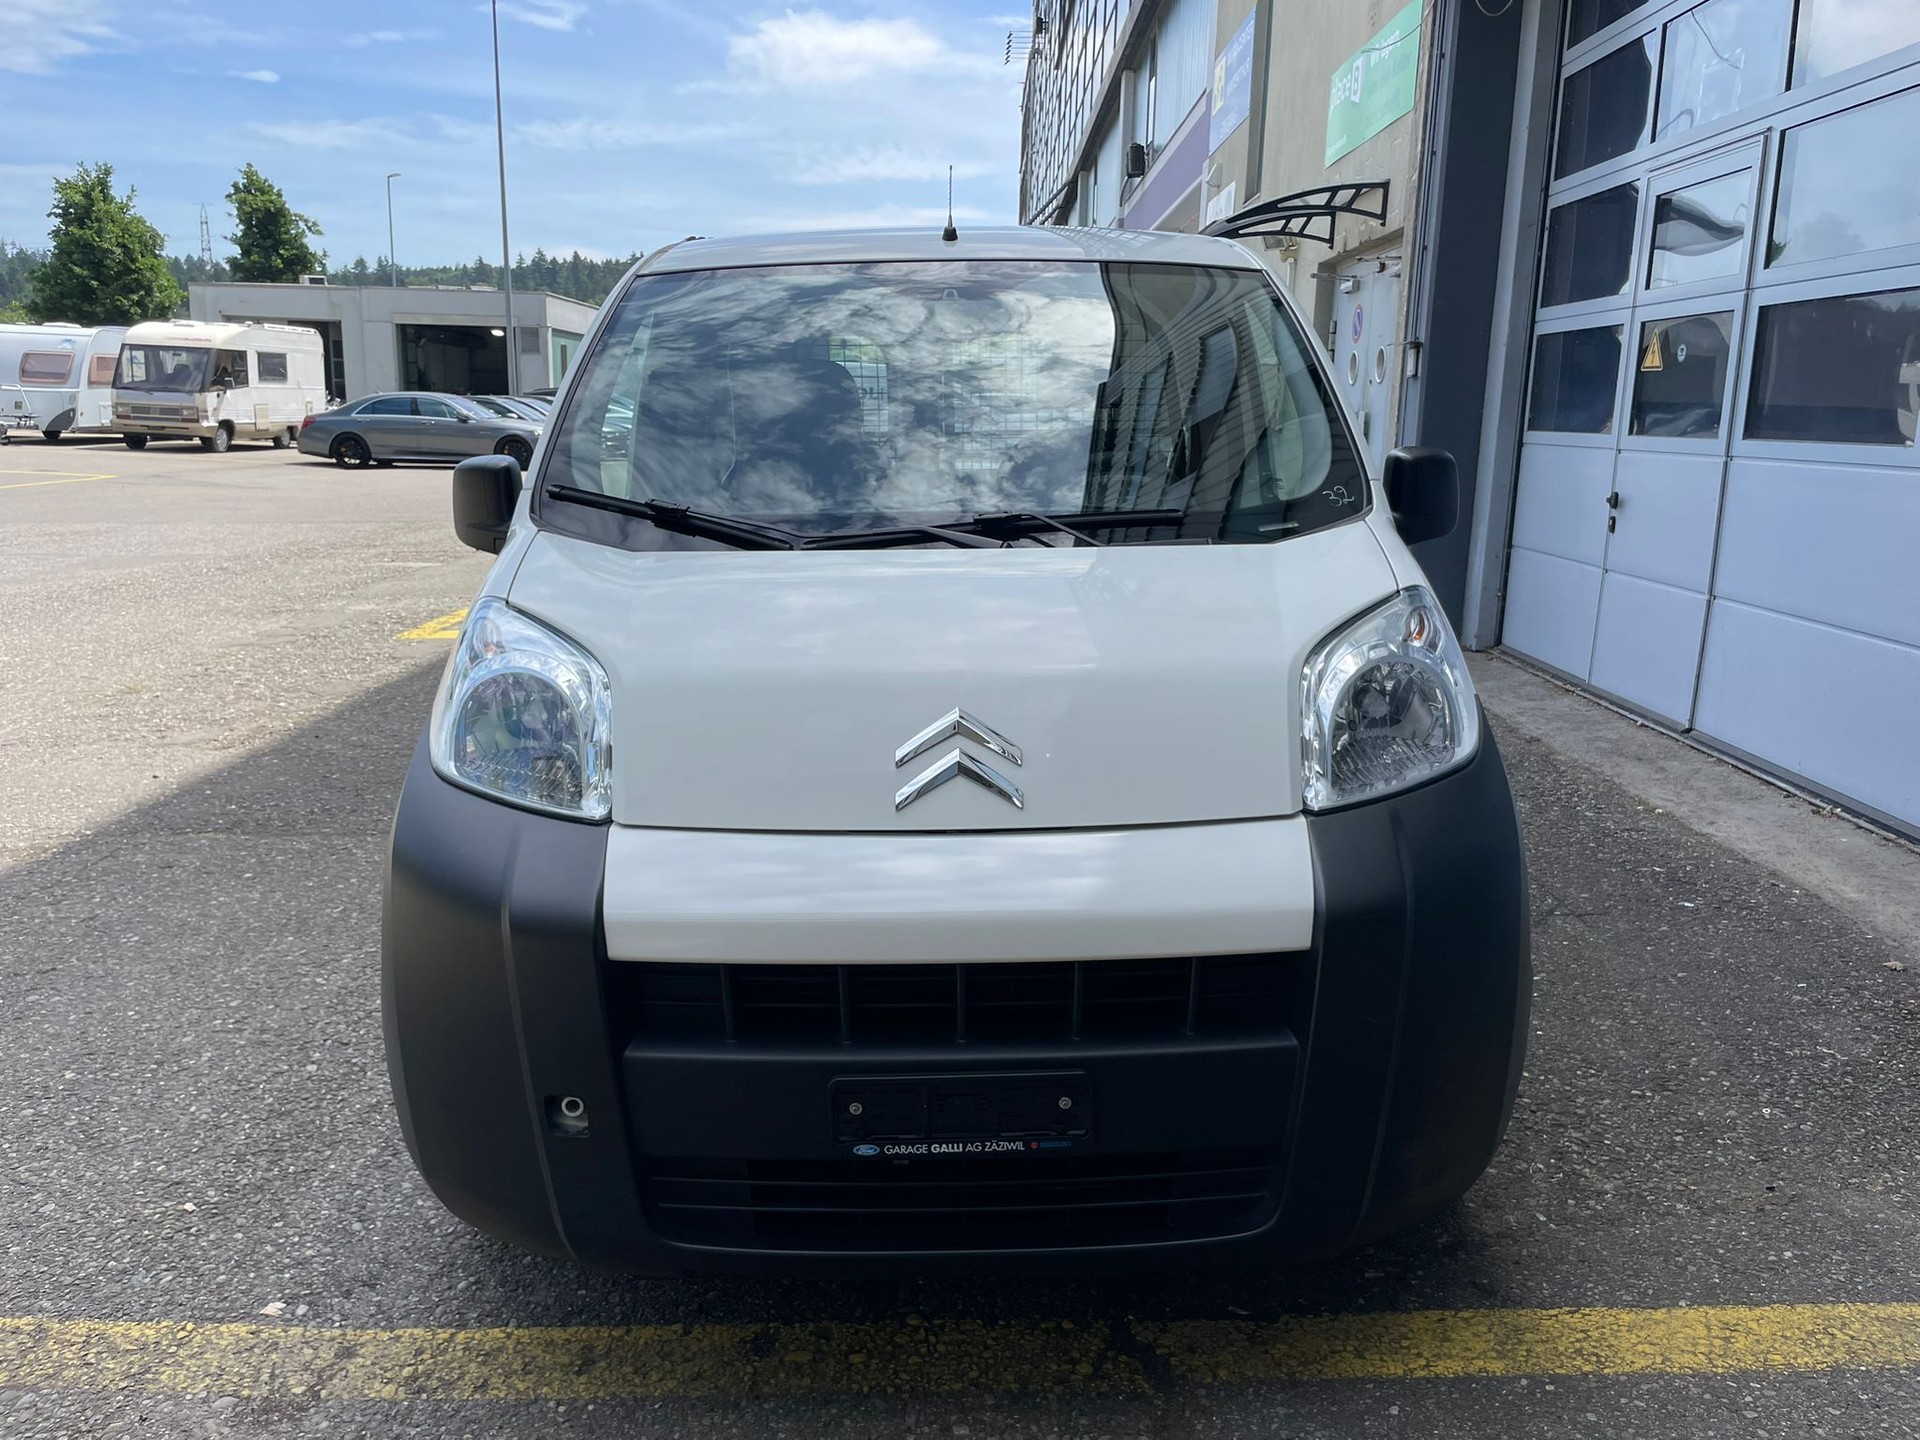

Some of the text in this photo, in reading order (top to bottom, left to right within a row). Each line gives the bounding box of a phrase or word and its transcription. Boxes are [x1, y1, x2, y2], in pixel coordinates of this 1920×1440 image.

[1322, 485, 1355, 507] 32
[884, 1144, 929, 1154] GARAGE
[931, 1143, 963, 1153] GALLI
[965, 1142, 982, 1152] AG
[984, 1140, 1025, 1152] ZÄZIWIL
